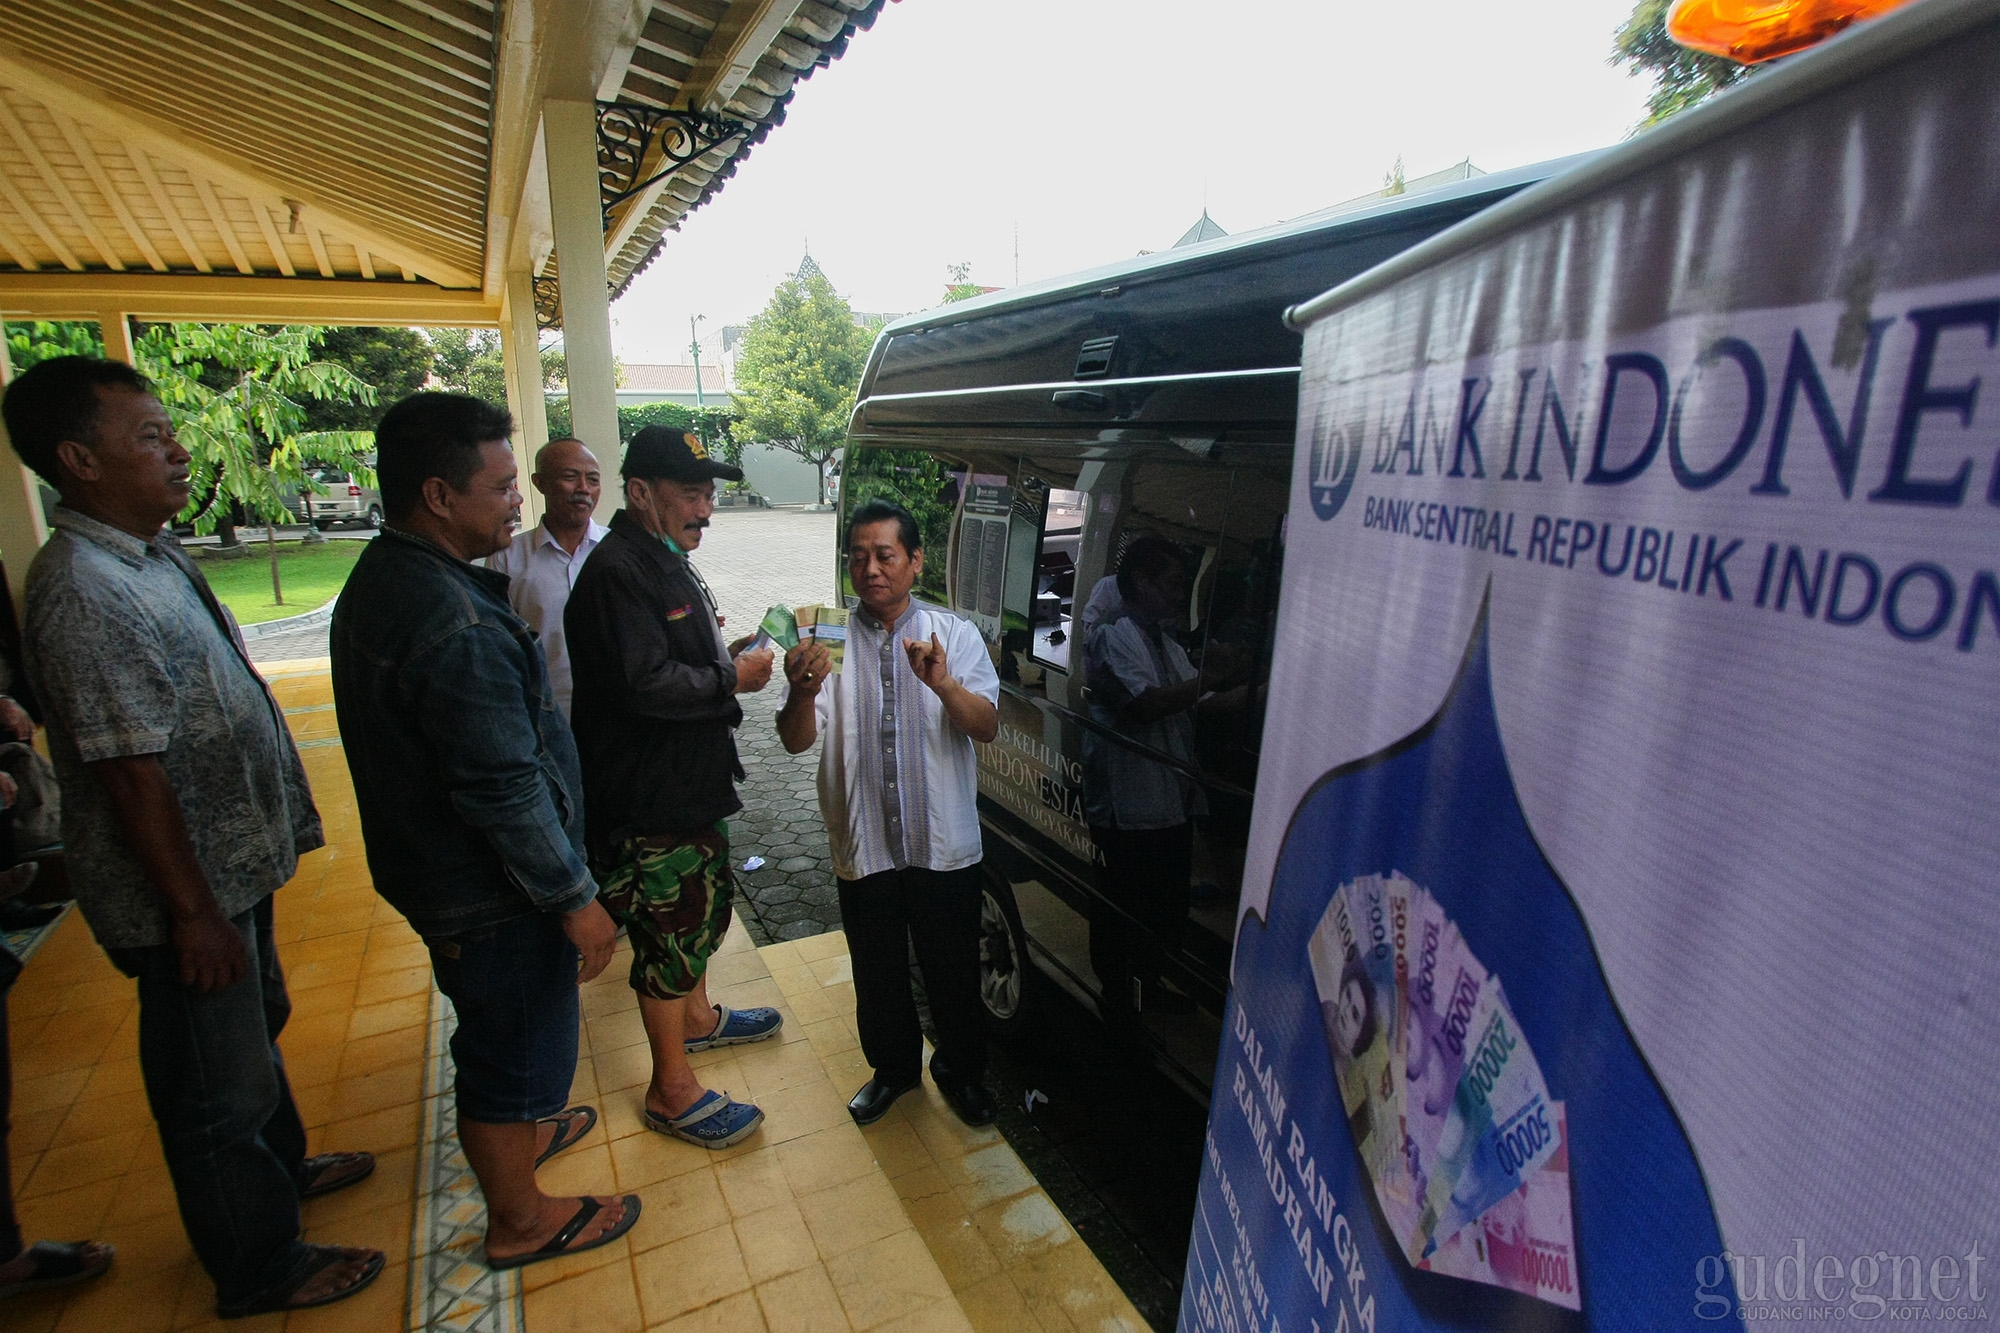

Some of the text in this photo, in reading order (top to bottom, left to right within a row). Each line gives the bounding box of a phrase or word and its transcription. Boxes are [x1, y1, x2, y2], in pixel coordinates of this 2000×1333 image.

[1371, 299, 2000, 508] BANK INDONE
[1363, 495, 1414, 536] BANK
[1414, 501, 1518, 558] SENTRAL
[1526, 514, 1745, 602] REPUBLIK
[981, 742, 1088, 828] INDONESIA
[1013, 728, 1082, 784] KELILING
[976, 767, 1107, 868] STIMEWA YOGYAKARTA
[1368, 892, 1387, 960] 2000
[1394, 896, 1407, 971] 5000
[1233, 1061, 1334, 1308] RAMADHAN
[1235, 1003, 1375, 1333] DALAM RANGKA
